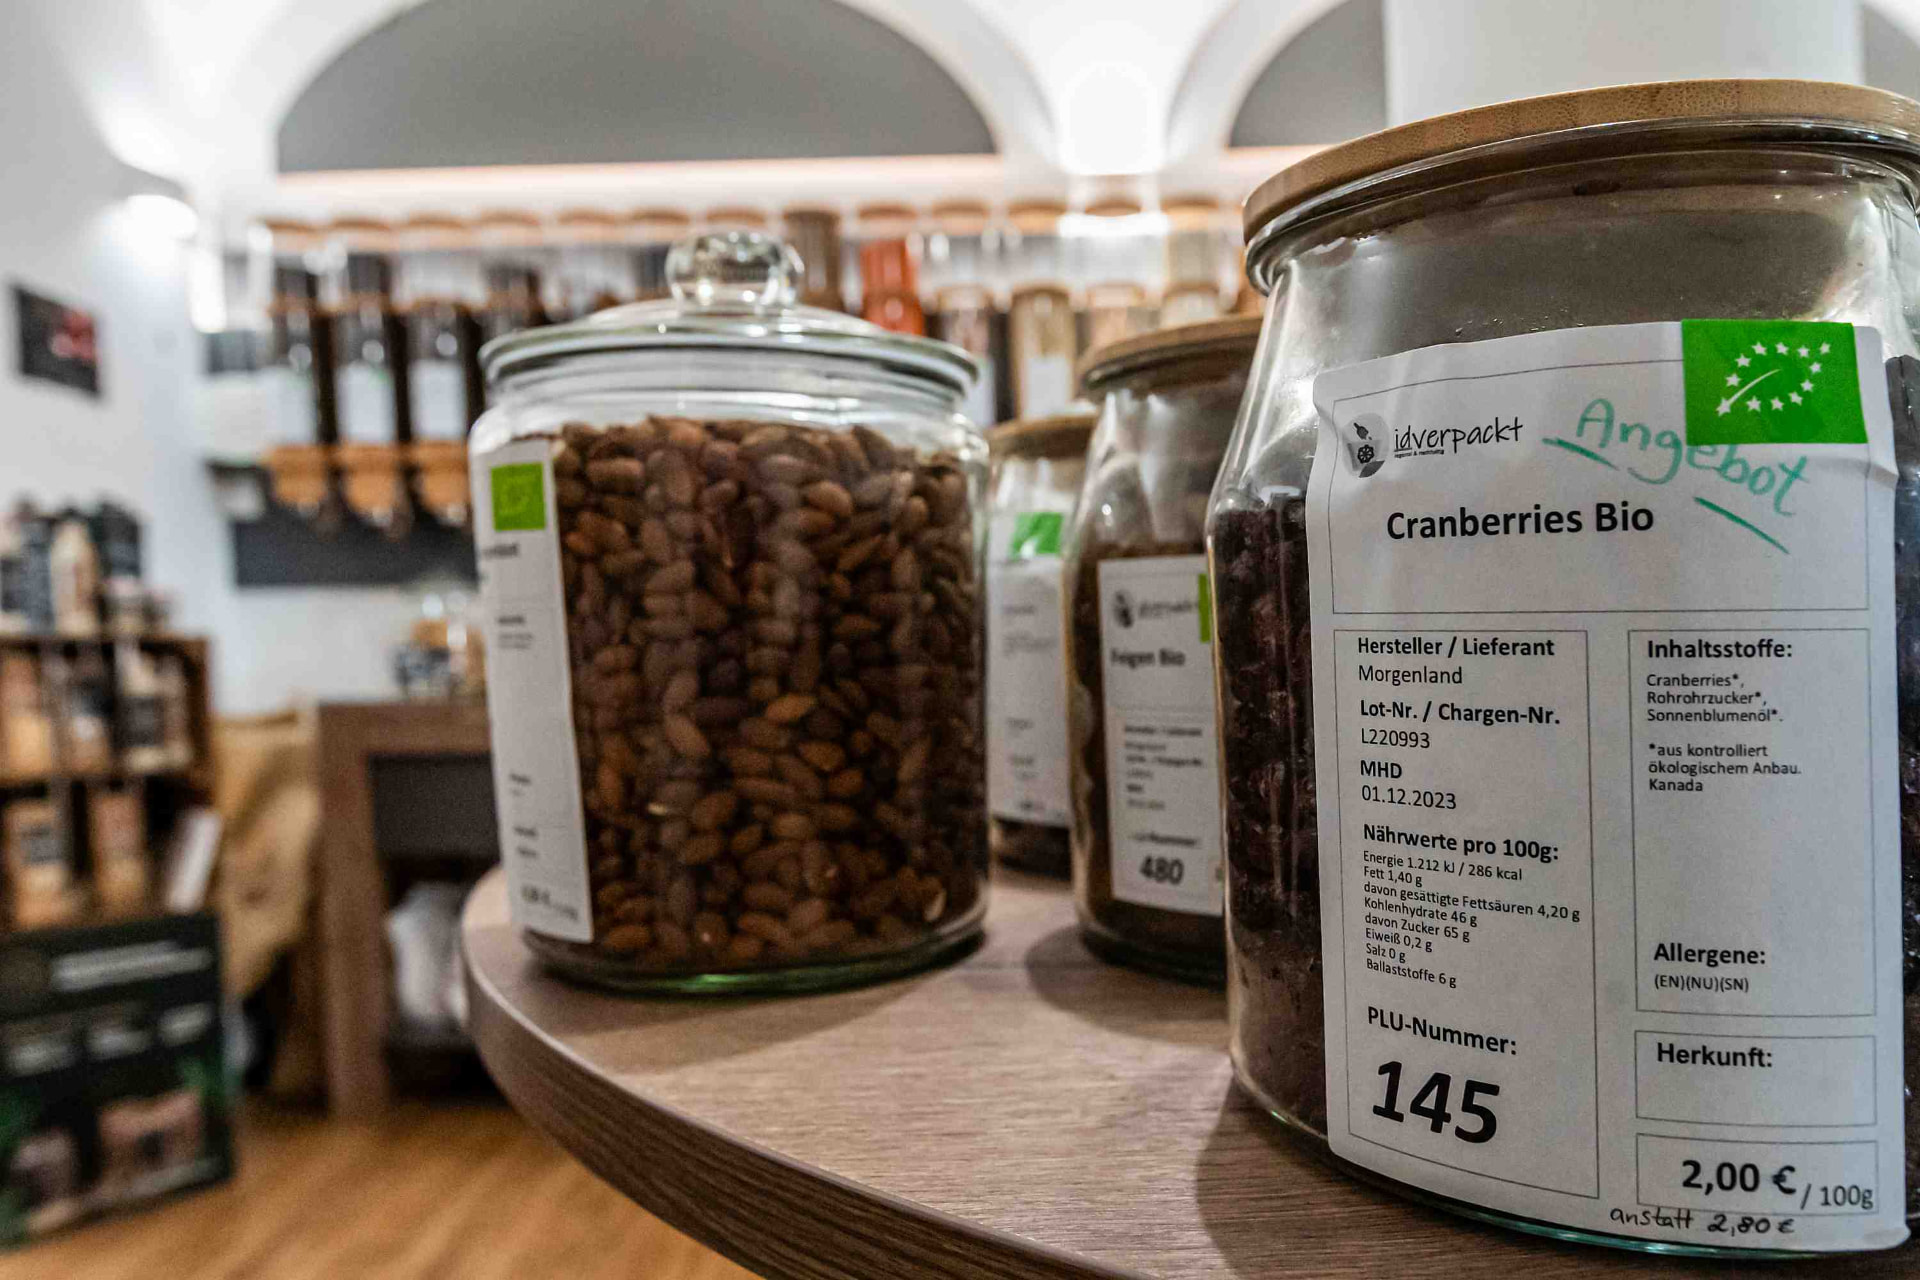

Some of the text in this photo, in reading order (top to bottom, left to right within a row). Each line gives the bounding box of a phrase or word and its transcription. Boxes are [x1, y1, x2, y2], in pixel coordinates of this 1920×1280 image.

[1395, 416, 1523, 454] idverpackt
[1576, 398, 1809, 517] Angebot
[1387, 500, 1654, 540] Cranberries Bio
[1358, 636, 1555, 658] Hersteller / Lieferant
[1648, 638, 1793, 659] Inhaltsstoffe:
[1358, 665, 1463, 686] Morgenland
[1361, 700, 1560, 726] Lot-Nr. / Chargen-Nr.
[1361, 728, 1430, 749] L220993
[1687, 743, 1768, 757] kontrolliert
[1360, 760, 1402, 779] MHD
[1648, 761, 1802, 777] ökologischem Anbau.
[1361, 785, 1457, 810] 01.12.2023
[1649, 779, 1703, 792] Kanada
[1363, 824, 1559, 863] Nährwerte pro 100g:
[1140, 855, 1184, 886] 480
[1363, 850, 1522, 881] Energie 1.212 kJ / 286 kcal
[1363, 866, 1423, 888] Fett 1,40 g
[1364, 881, 1581, 923] davon gesättigte Fettsäuren 4,20 g
[1364, 897, 1478, 928] Kohlenhydrate 46 g
[1365, 913, 1470, 943] davon Zucker 65 g
[1365, 928, 1433, 953] Eiweiß 0,2 g
[1366, 943, 1406, 964] Salz 0 g
[1654, 942, 1766, 968] Allergene:
[1366, 958, 1457, 989] Ballaststoffe 6 g
[1654, 974, 1750, 993] (EN)(NU)(SN)
[1368, 1006, 1517, 1056] PLU-Nummer:
[1657, 1042, 1773, 1068] Herkunft:
[1373, 1060, 1500, 1144] 145
[1682, 1159, 1874, 1210] 2,00 € / 100g
[1610, 1207, 1795, 1237] anstatt 2,80 €
